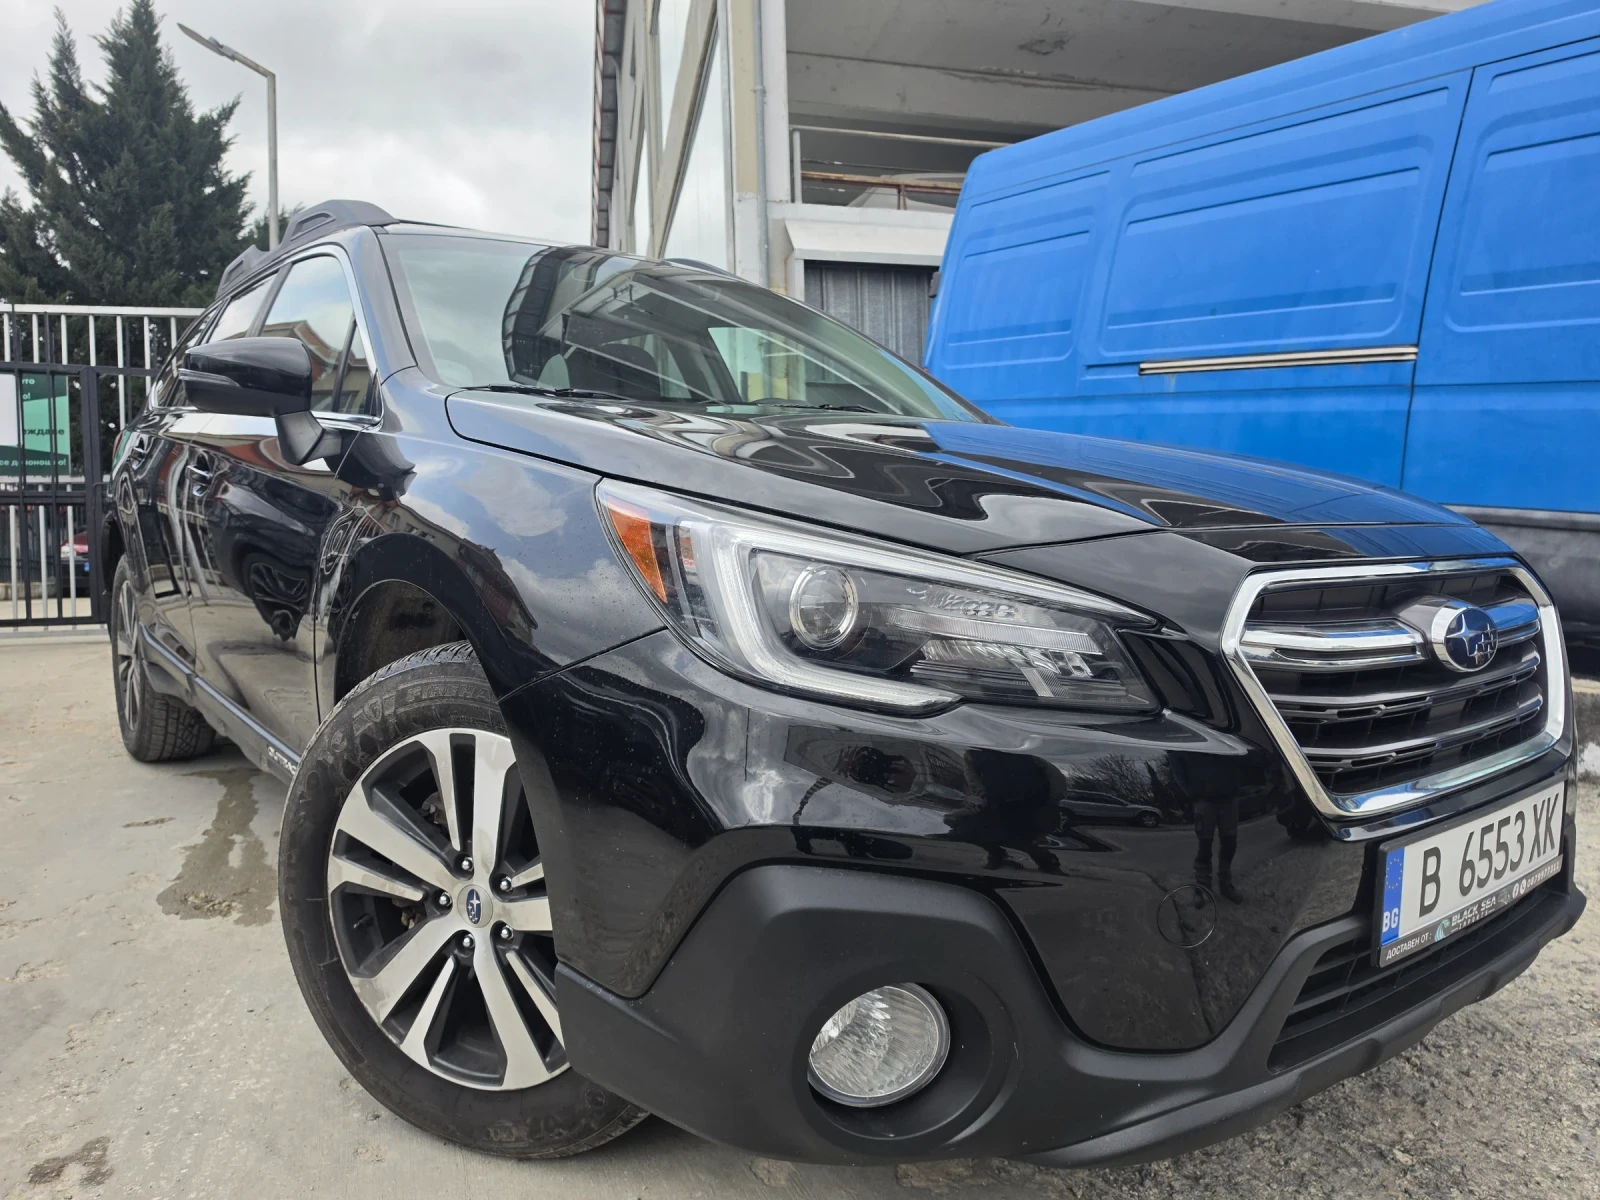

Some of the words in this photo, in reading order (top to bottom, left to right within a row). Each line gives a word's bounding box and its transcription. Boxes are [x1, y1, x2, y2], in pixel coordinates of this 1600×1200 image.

[1418, 846, 1442, 918] B
[1458, 810, 1526, 897] 6553
[1528, 792, 1560, 864] XK
[1382, 907, 1399, 933] BG
[1451, 903, 1479, 927] BLACK
[1480, 895, 1496, 912] SEA
[1386, 936, 1420, 960] ДОСТАВЕН
